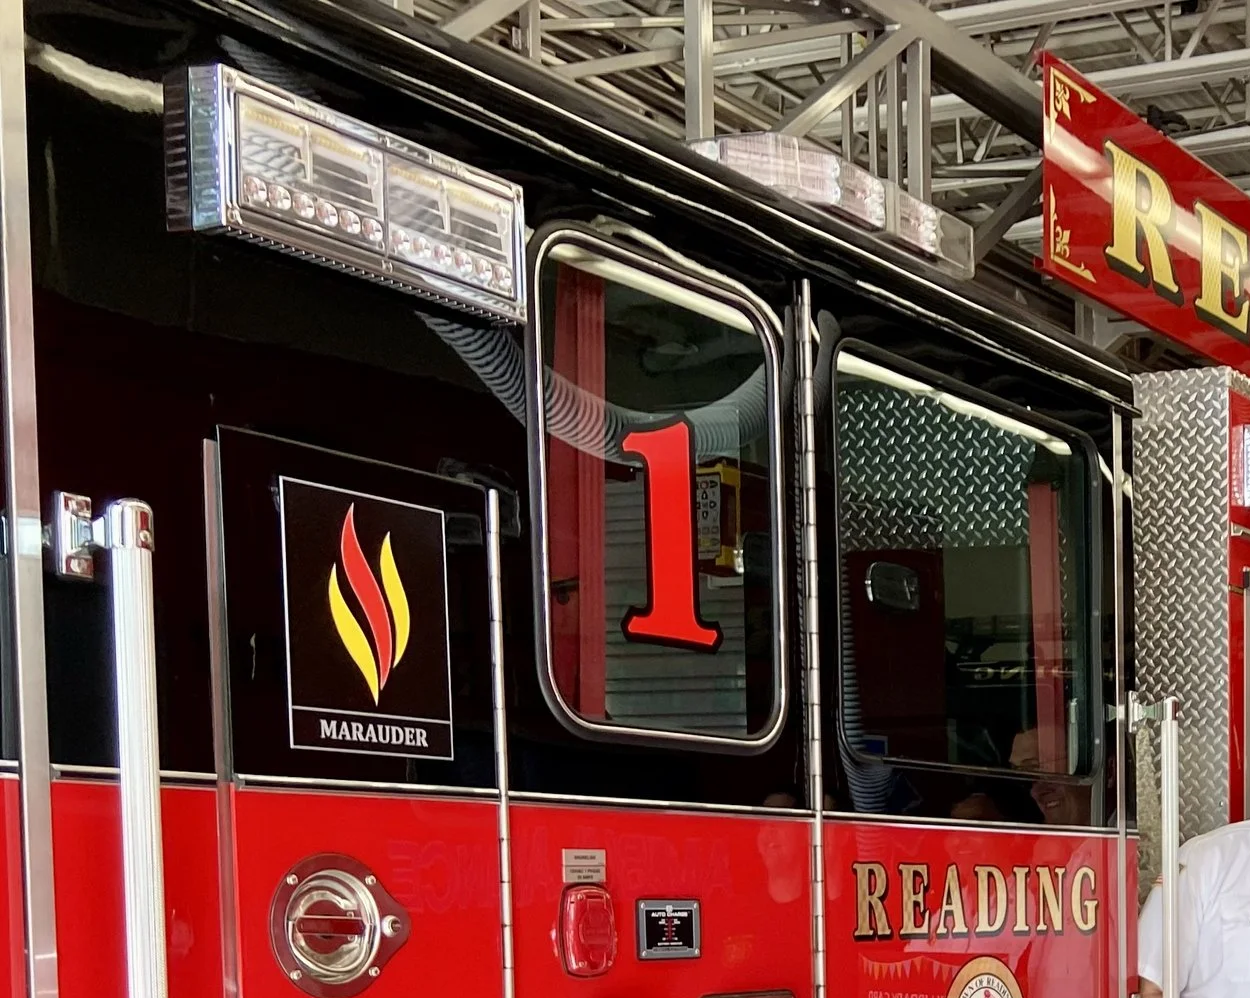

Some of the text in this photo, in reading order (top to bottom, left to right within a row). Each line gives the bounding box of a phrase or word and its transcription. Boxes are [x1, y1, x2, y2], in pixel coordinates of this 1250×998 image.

[621, 416, 721, 650] 1
[320, 719, 428, 748] MARAUDER
[852, 862, 1099, 941] READING
[975, 978, 984, 988] OF
